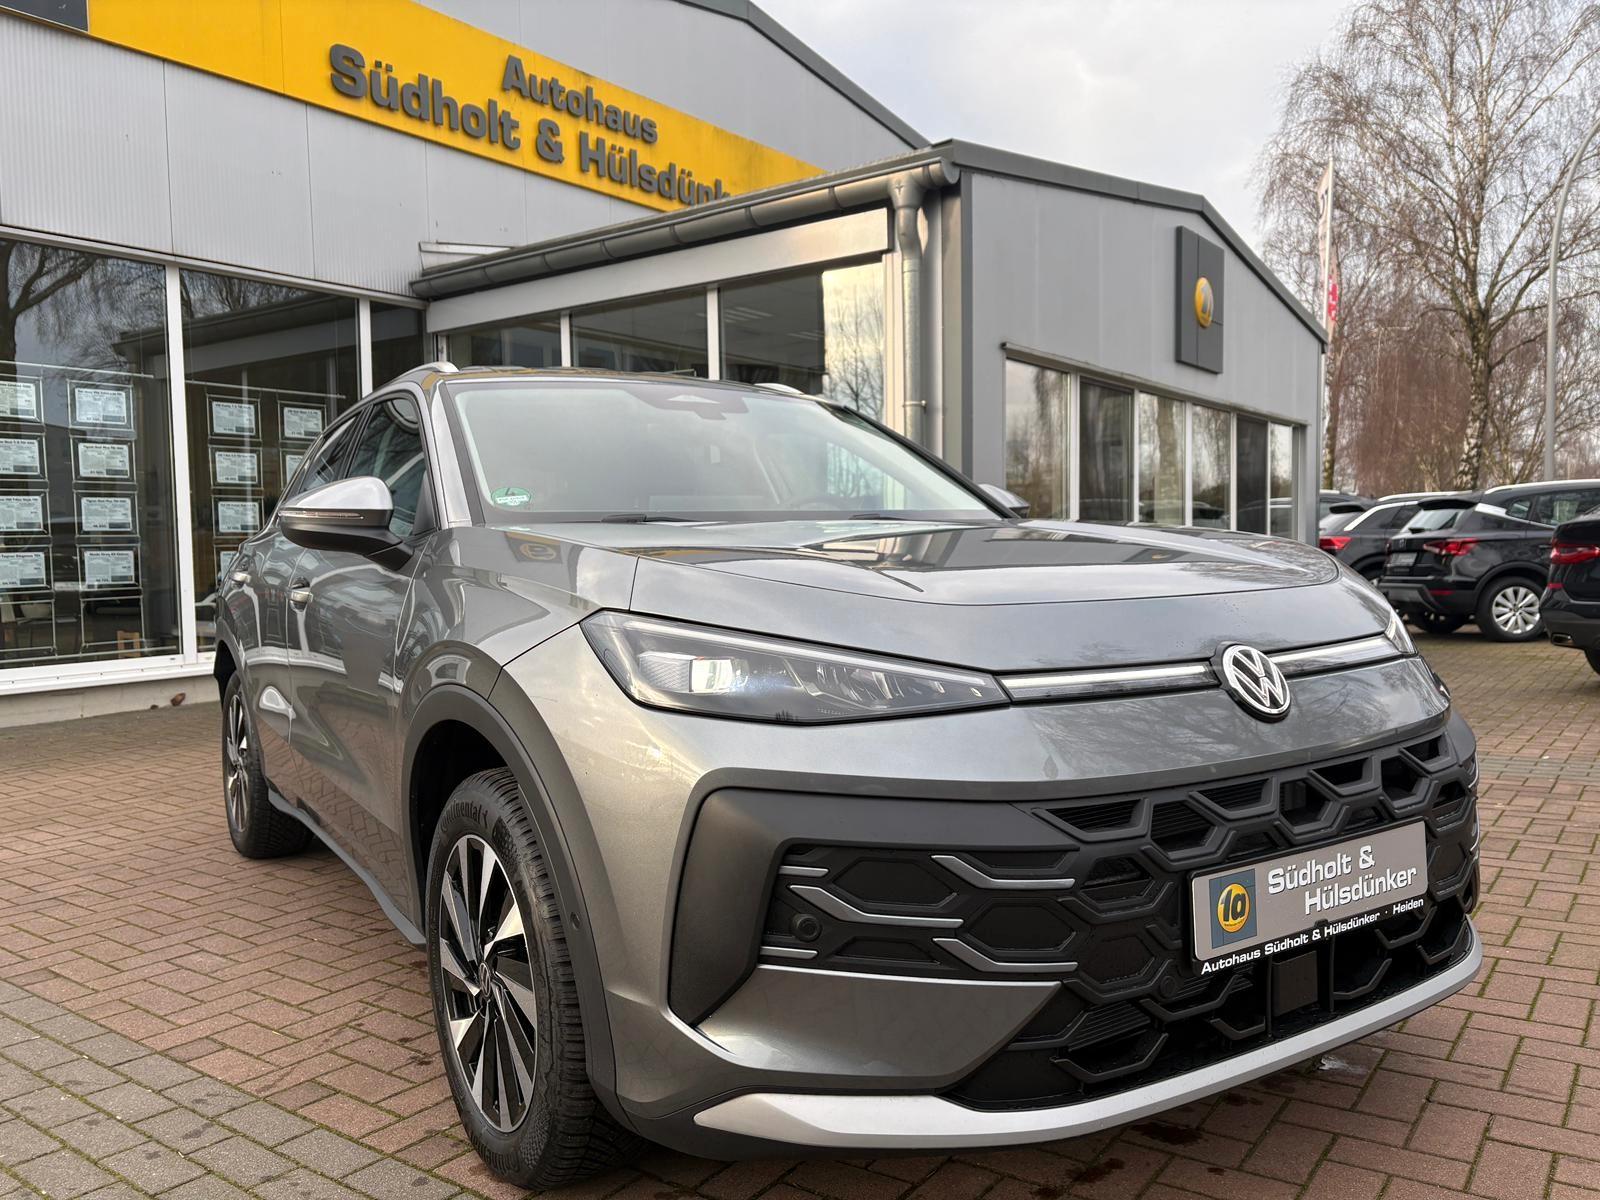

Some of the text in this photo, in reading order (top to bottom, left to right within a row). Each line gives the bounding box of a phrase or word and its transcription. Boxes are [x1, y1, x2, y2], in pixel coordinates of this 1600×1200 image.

[329, 43, 521, 150] Südholt
[536, 118, 565, 163] &
[502, 54, 658, 144] Autohaus
[1267, 845, 1375, 894] Südholt &
[1304, 867, 1417, 915] Hülsdünker
[1221, 888, 1247, 921] 1a
[1200, 898, 1424, 975] Autohaus Südholt & Hülsdünker Heiden
